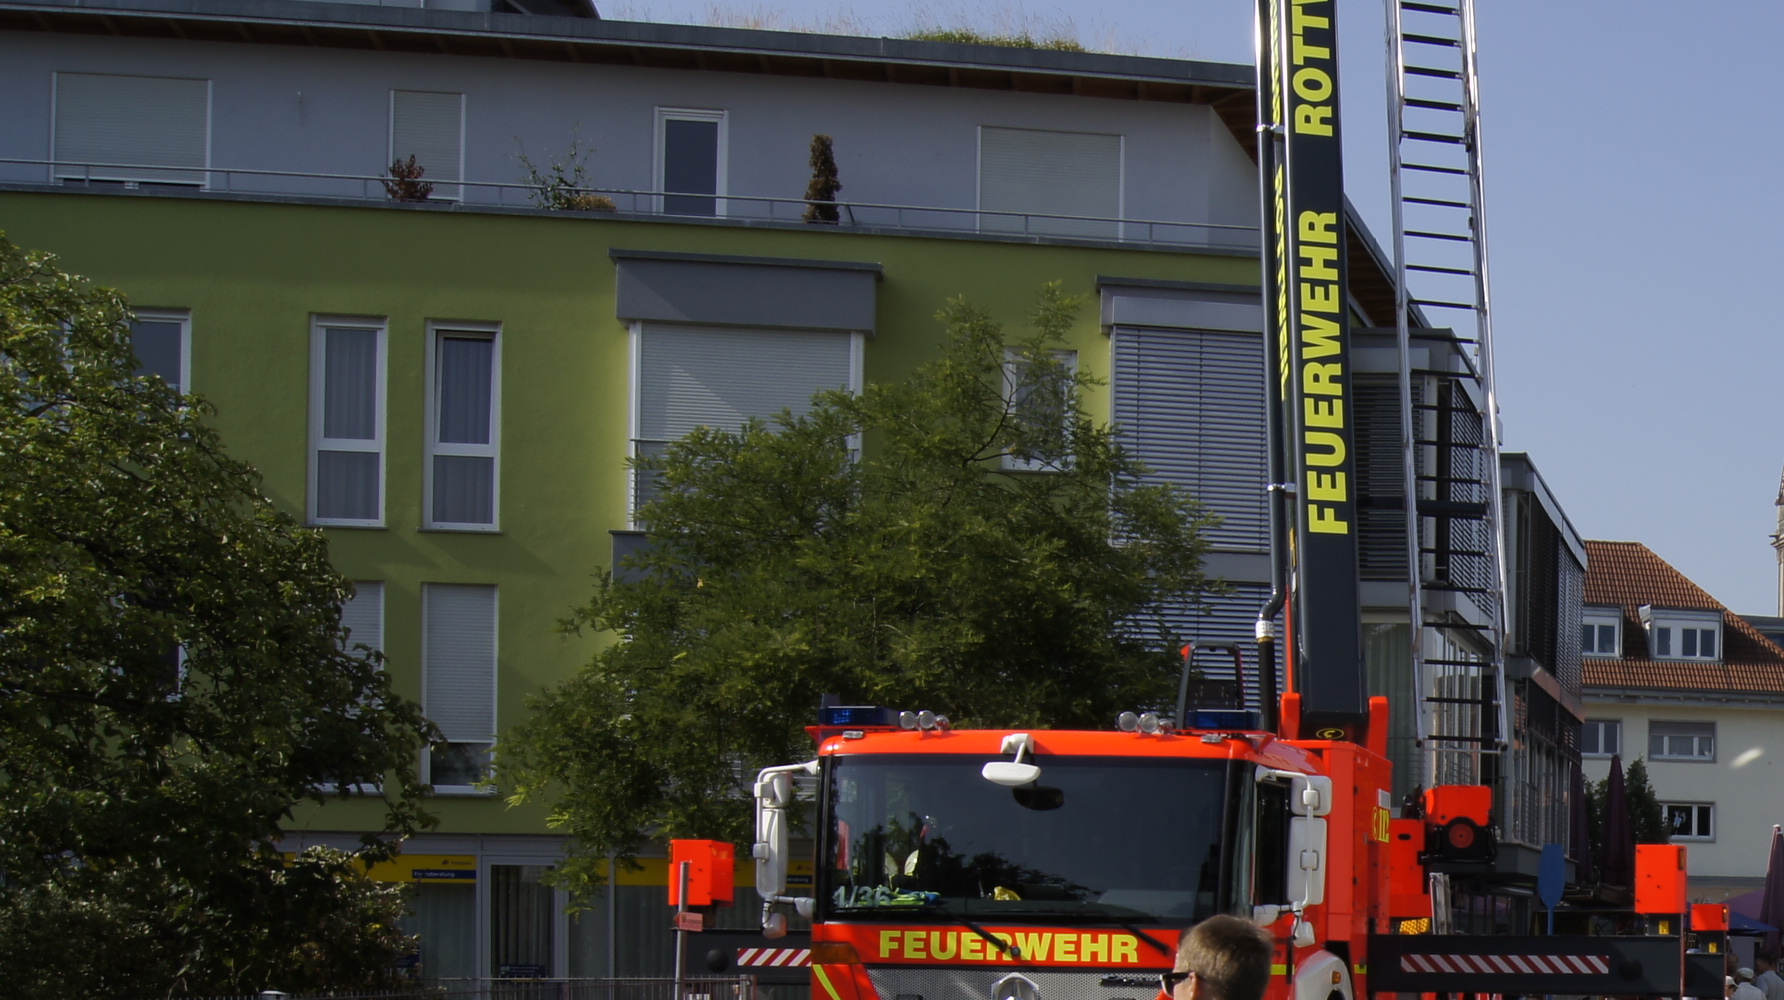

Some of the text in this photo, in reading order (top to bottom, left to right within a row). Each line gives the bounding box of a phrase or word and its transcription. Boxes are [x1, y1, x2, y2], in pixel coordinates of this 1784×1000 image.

[1291, 0, 1348, 534] FEUERWEHR ROTT
[879, 930, 1139, 963] FEUERWEHR
